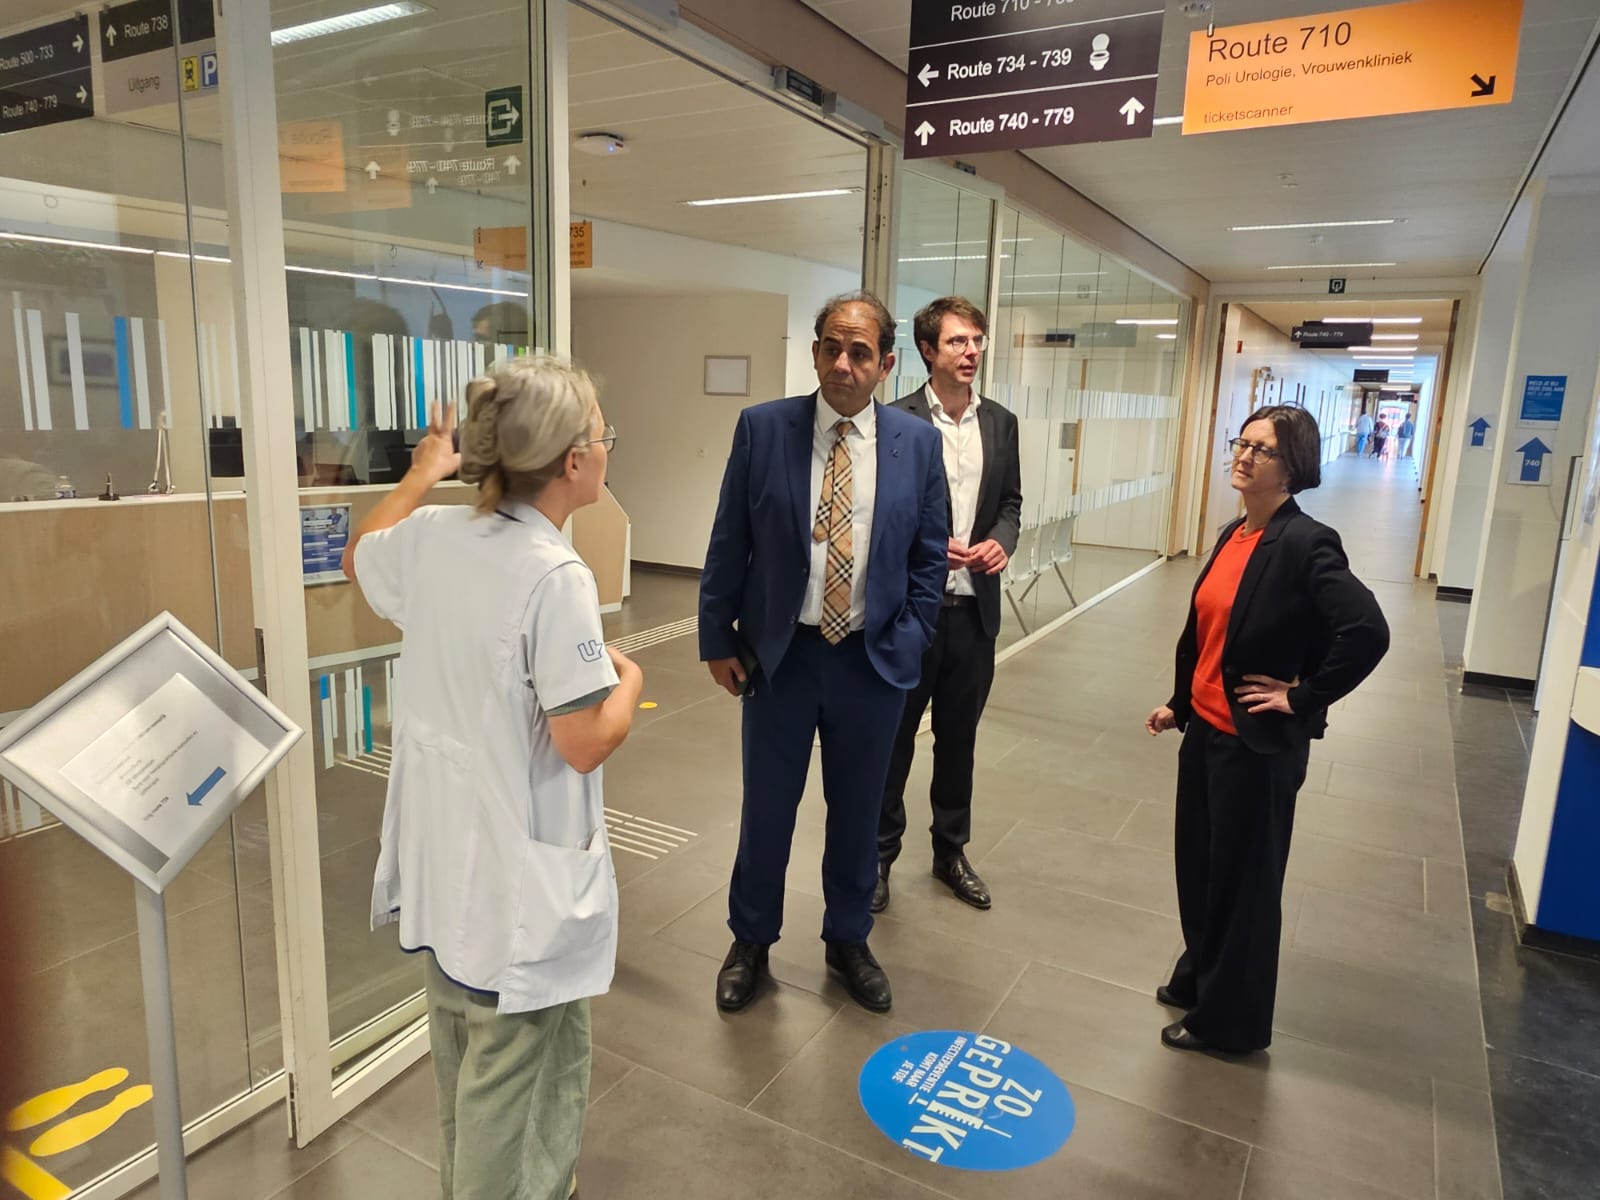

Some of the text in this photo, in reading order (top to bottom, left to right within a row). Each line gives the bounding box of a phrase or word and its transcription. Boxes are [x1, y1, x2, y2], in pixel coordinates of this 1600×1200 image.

[951, 2, 996, 22] Route
[124, 14, 168, 38] Route 738
[1208, 21, 1351, 62] Route 710
[0, 56, 19, 70] Route
[203, 56, 217, 86] P
[947, 58, 992, 80] Route
[997, 54, 1026, 74] 734
[1041, 48, 1072, 68] 739
[1205, 51, 1413, 87] Poli Urologie, Vrouwenkliniek
[128, 75, 160, 94] Uitgang
[2, 104, 24, 119] Route
[43, 94, 58, 110] 779
[1203, 104, 1293, 124] ticketscanner
[949, 116, 994, 136] Route
[999, 112, 1028, 131] 740
[1043, 107, 1075, 126] 779
[1524, 459, 1540, 467] 740
[902, 1060, 915, 1070] JE
[993, 1078, 1042, 1118] ZO
